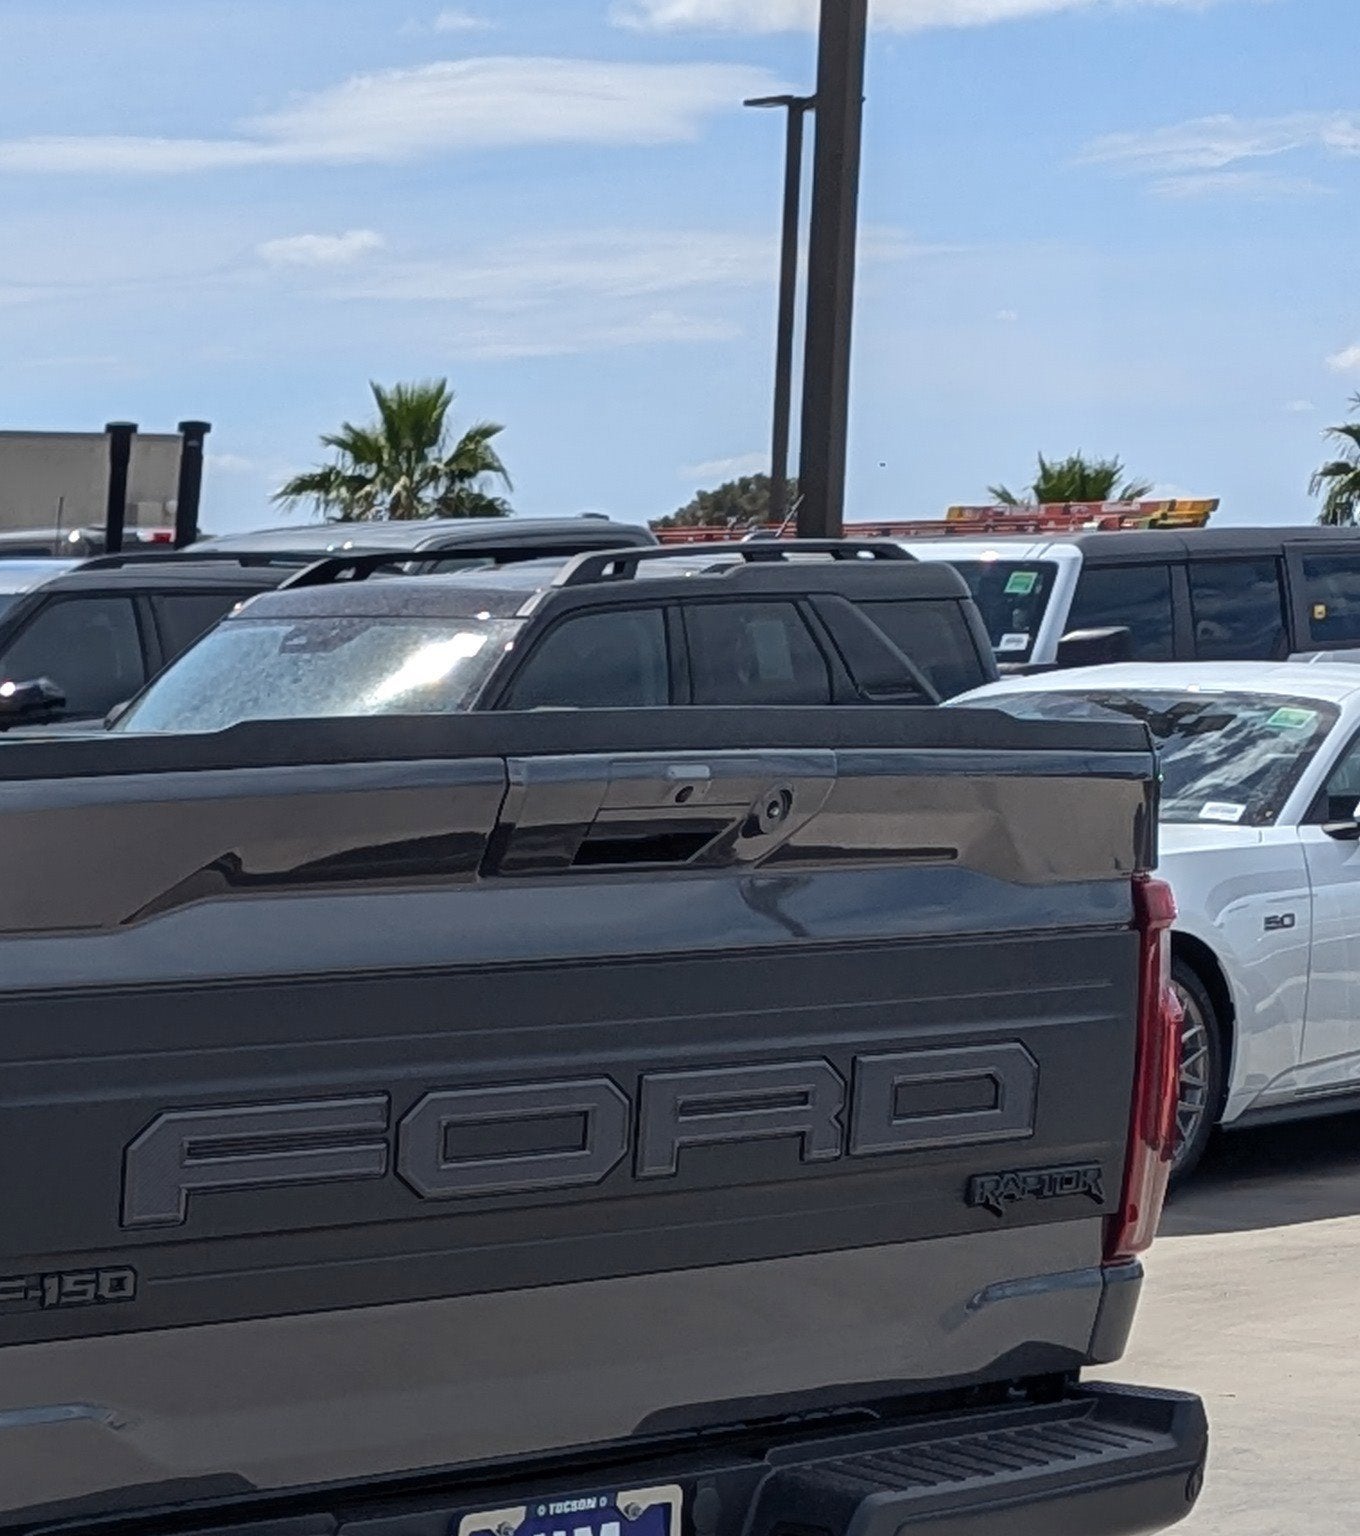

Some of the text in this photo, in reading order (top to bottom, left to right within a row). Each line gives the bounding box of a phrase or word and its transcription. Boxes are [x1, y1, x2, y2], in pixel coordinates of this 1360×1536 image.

[119, 1039, 1041, 1228] FORD
[965, 1160, 1105, 1217] RAPTOR
[548, 1497, 597, 1515] TUCSON
